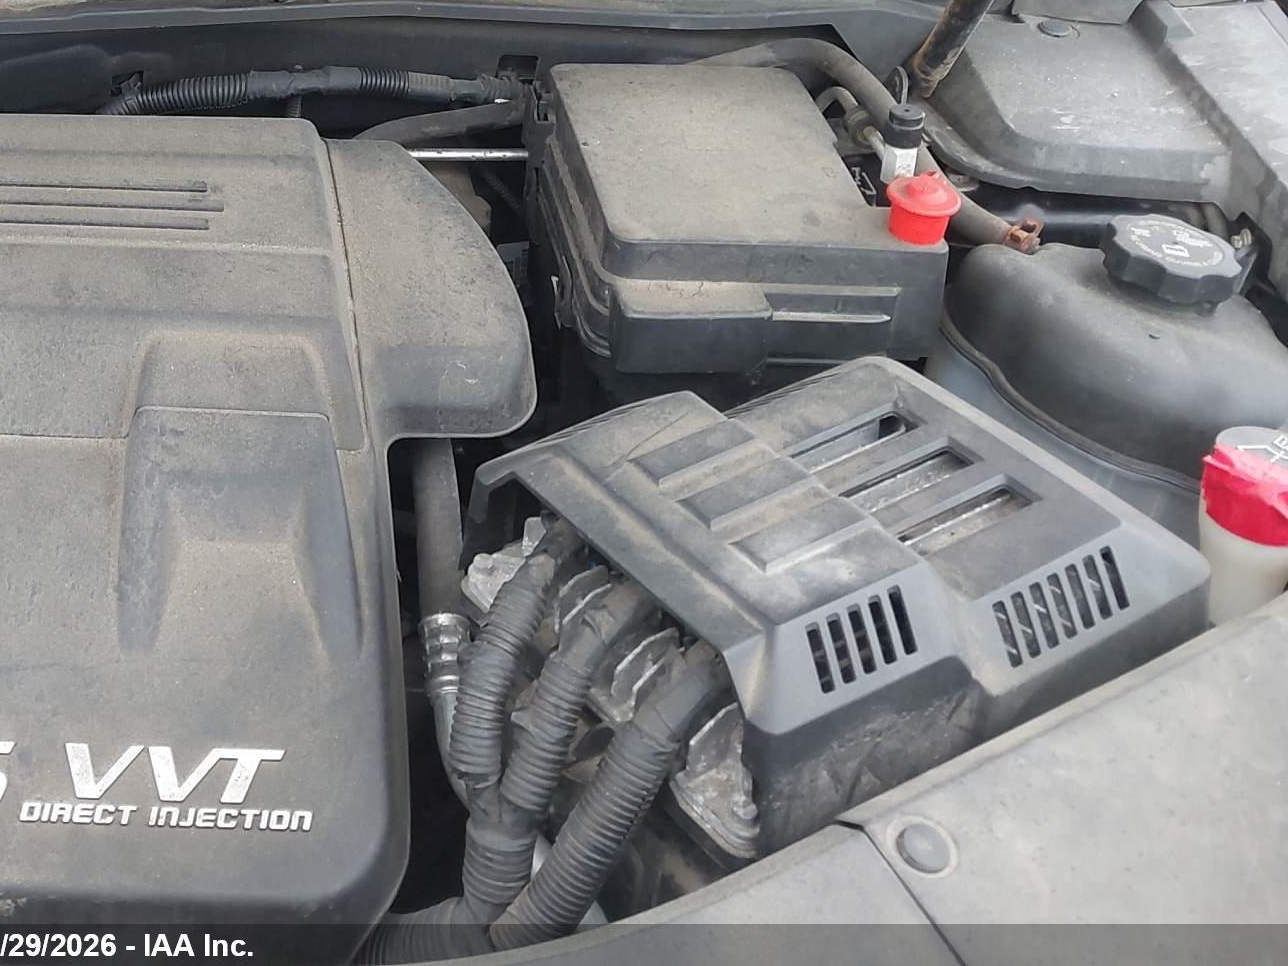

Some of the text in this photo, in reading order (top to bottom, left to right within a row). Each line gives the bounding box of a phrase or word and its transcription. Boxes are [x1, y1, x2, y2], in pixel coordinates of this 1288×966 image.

[65, 742, 286, 804] VVT
[19, 803, 313, 832] DIRECT INJECTION
